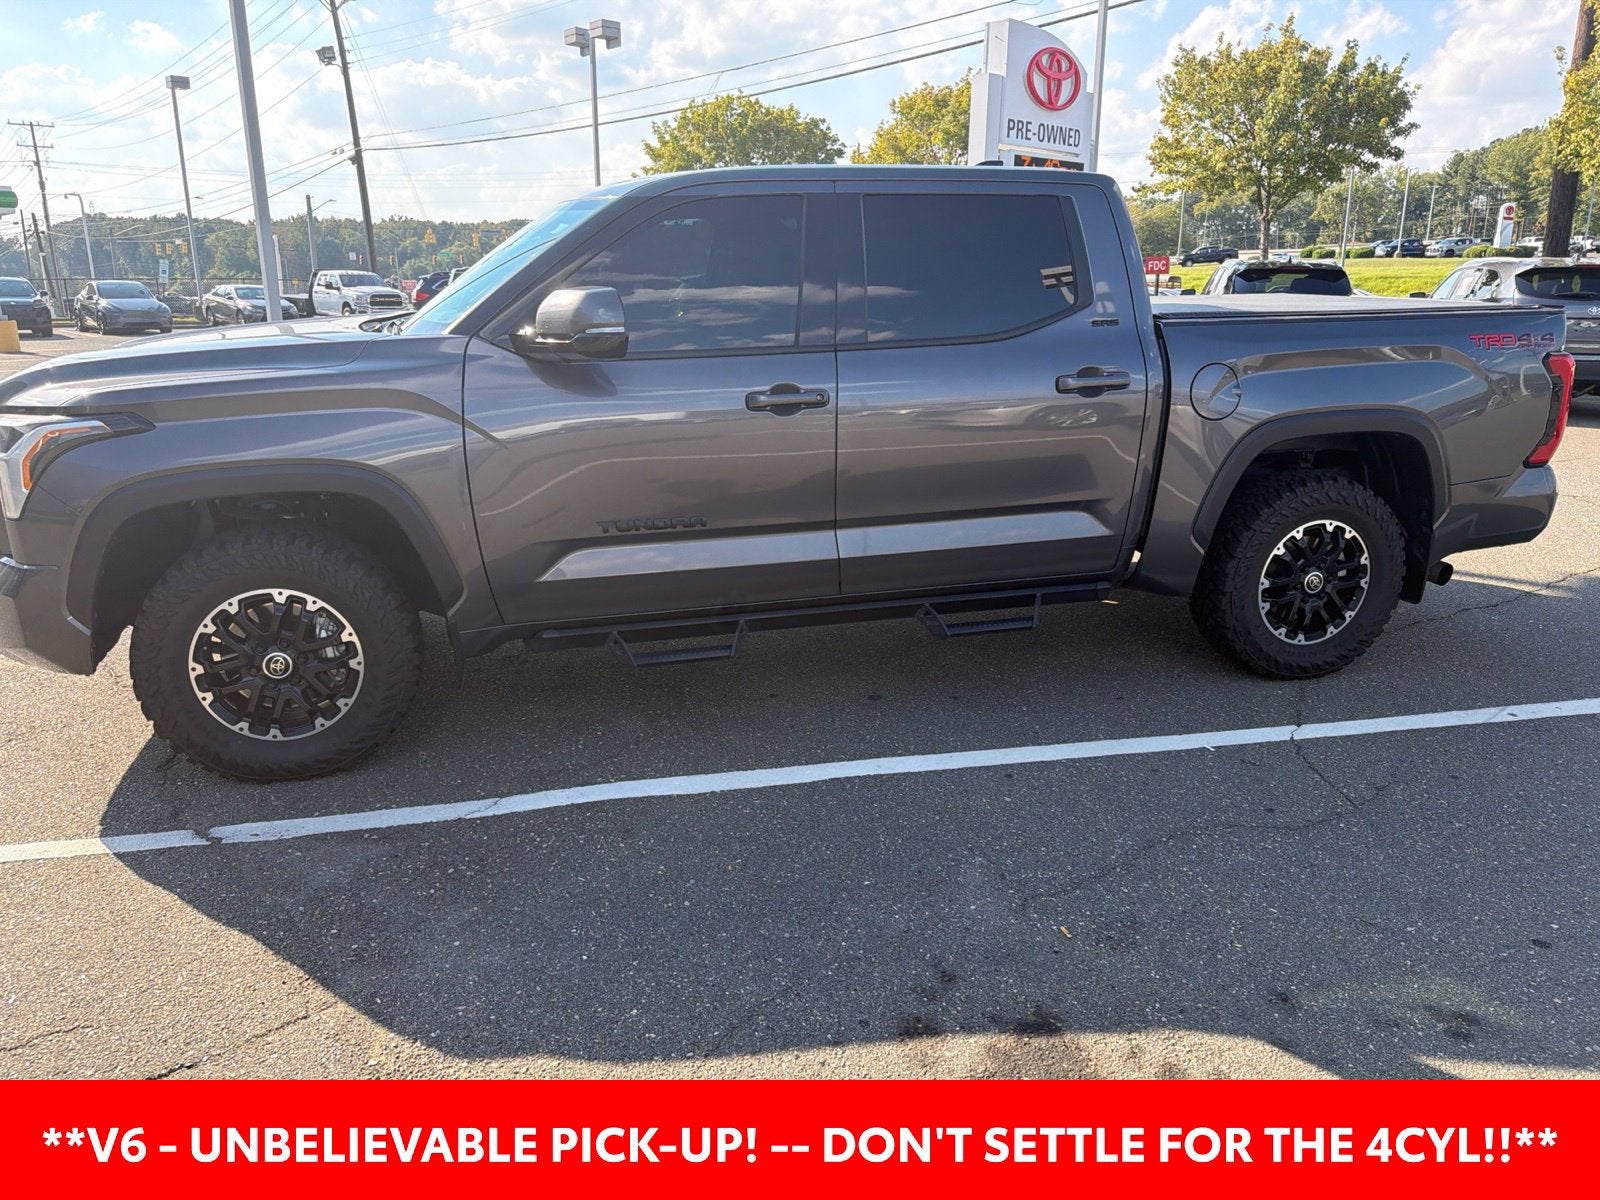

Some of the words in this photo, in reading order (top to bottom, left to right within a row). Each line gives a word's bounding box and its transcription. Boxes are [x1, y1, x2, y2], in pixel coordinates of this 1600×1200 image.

[1006, 118, 1081, 148] PRE-OWNED
[1148, 260, 1167, 271] FDC
[1469, 333, 1517, 350] TRD
[596, 516, 707, 533] TUNDRA
